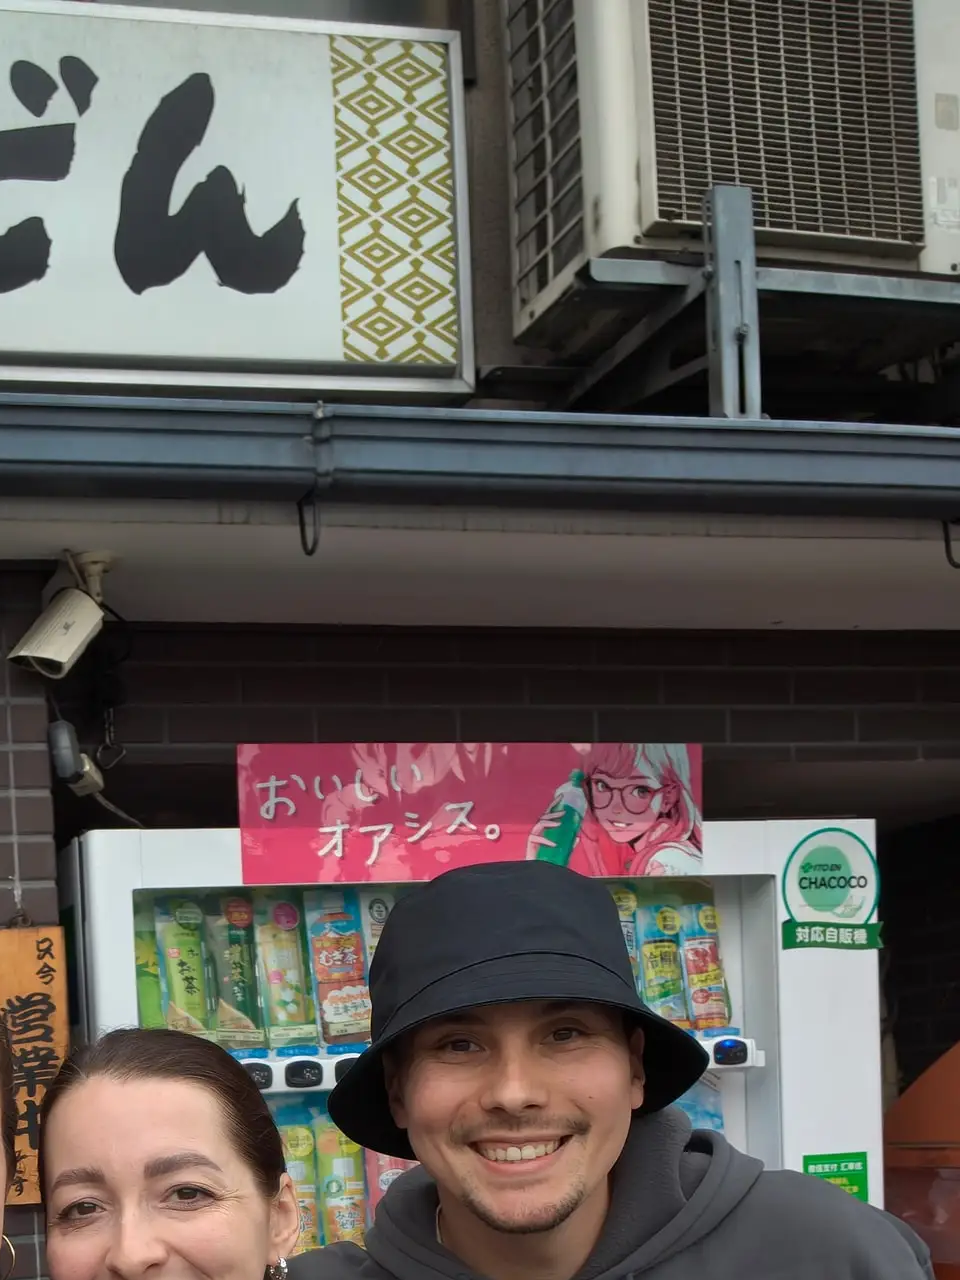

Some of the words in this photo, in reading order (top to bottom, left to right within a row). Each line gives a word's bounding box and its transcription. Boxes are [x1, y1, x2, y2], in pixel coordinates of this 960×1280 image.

[256, 764, 423, 820] おいしい
[317, 801, 501, 866] オアシス。
[799, 876, 868, 889] CHACOCO
[796, 926, 868, 944] 対応自販機
